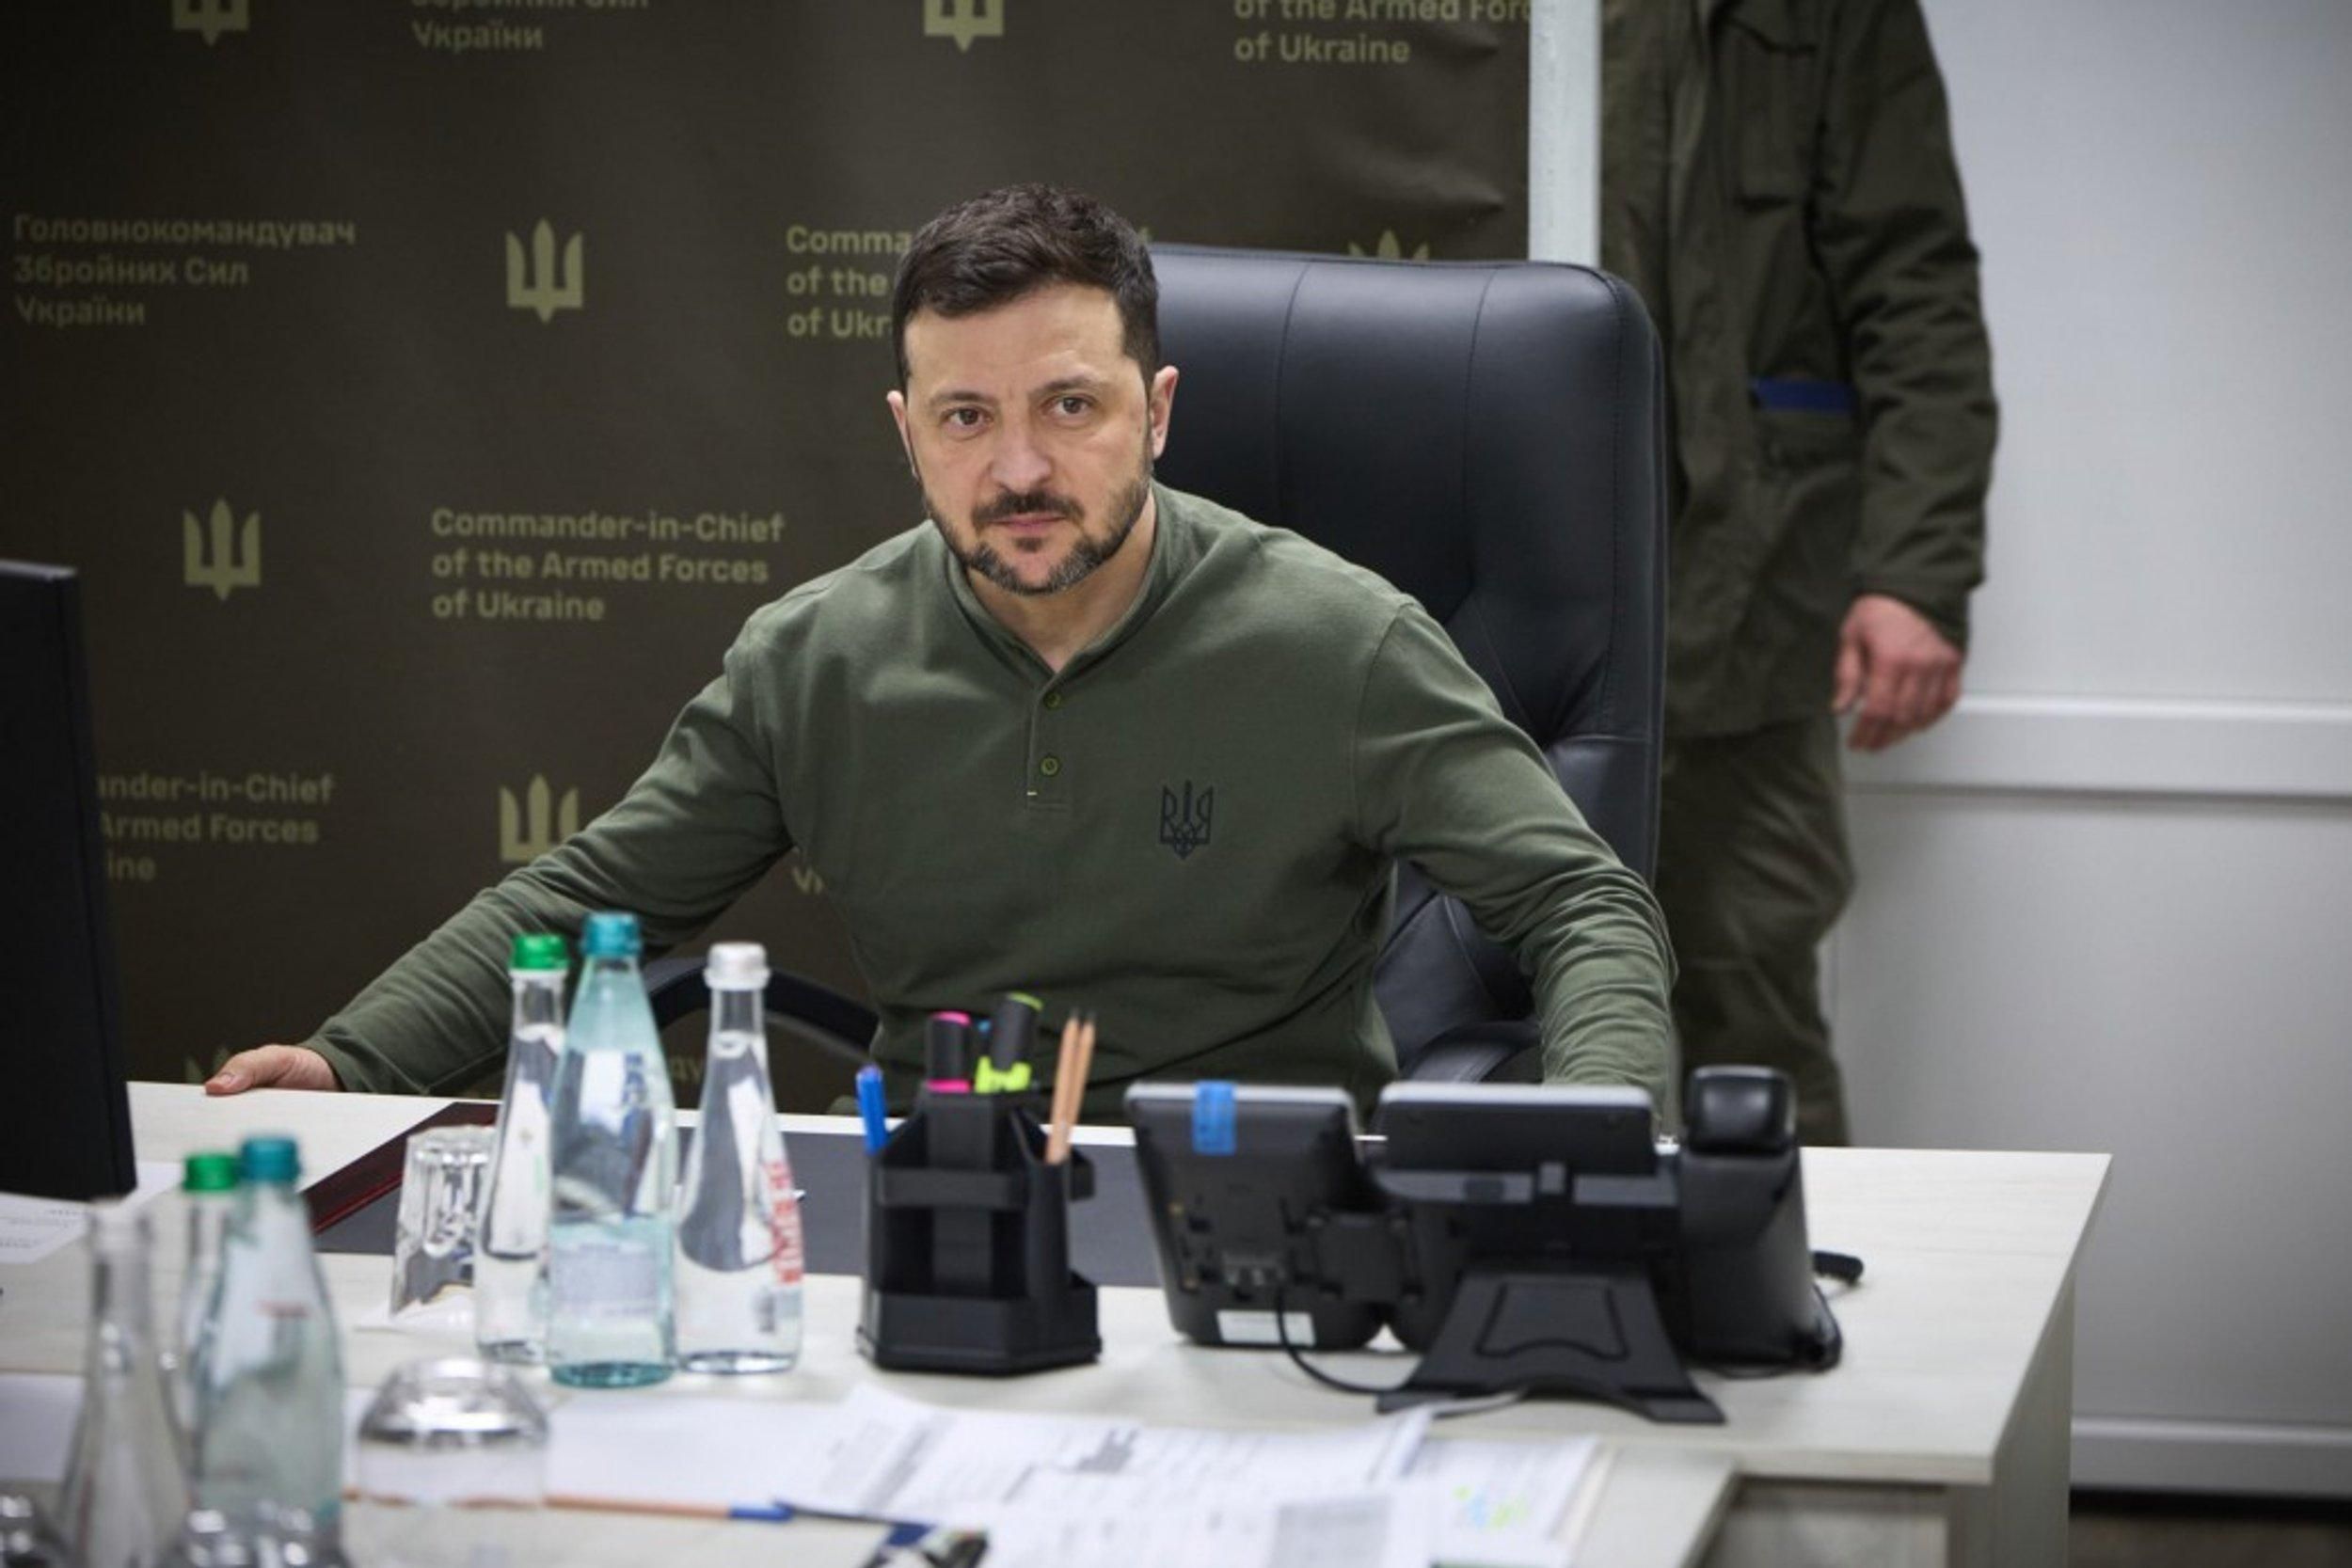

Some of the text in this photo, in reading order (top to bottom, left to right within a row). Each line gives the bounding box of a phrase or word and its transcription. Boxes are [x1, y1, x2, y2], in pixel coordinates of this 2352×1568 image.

[1234, 0, 1531, 22] of the Armed For
[411, 19, 544, 55] України
[1234, 33, 1411, 63] of Ukraine
[14, 214, 358, 250] Головнокомандувач
[787, 226, 913, 254] Comma
[14, 253, 250, 286] Збройних Сил
[787, 265, 889, 296] of the
[14, 293, 146, 327] України
[787, 308, 893, 338] of Ukr
[431, 508, 787, 543] Commander-in-Chief
[432, 548, 770, 583] of the Armed Forces
[432, 589, 606, 621] of Ukraine
[97, 770, 334, 804] nder-in-Chief
[209, 814, 321, 844] Forces
[107, 848, 157, 882] ine
